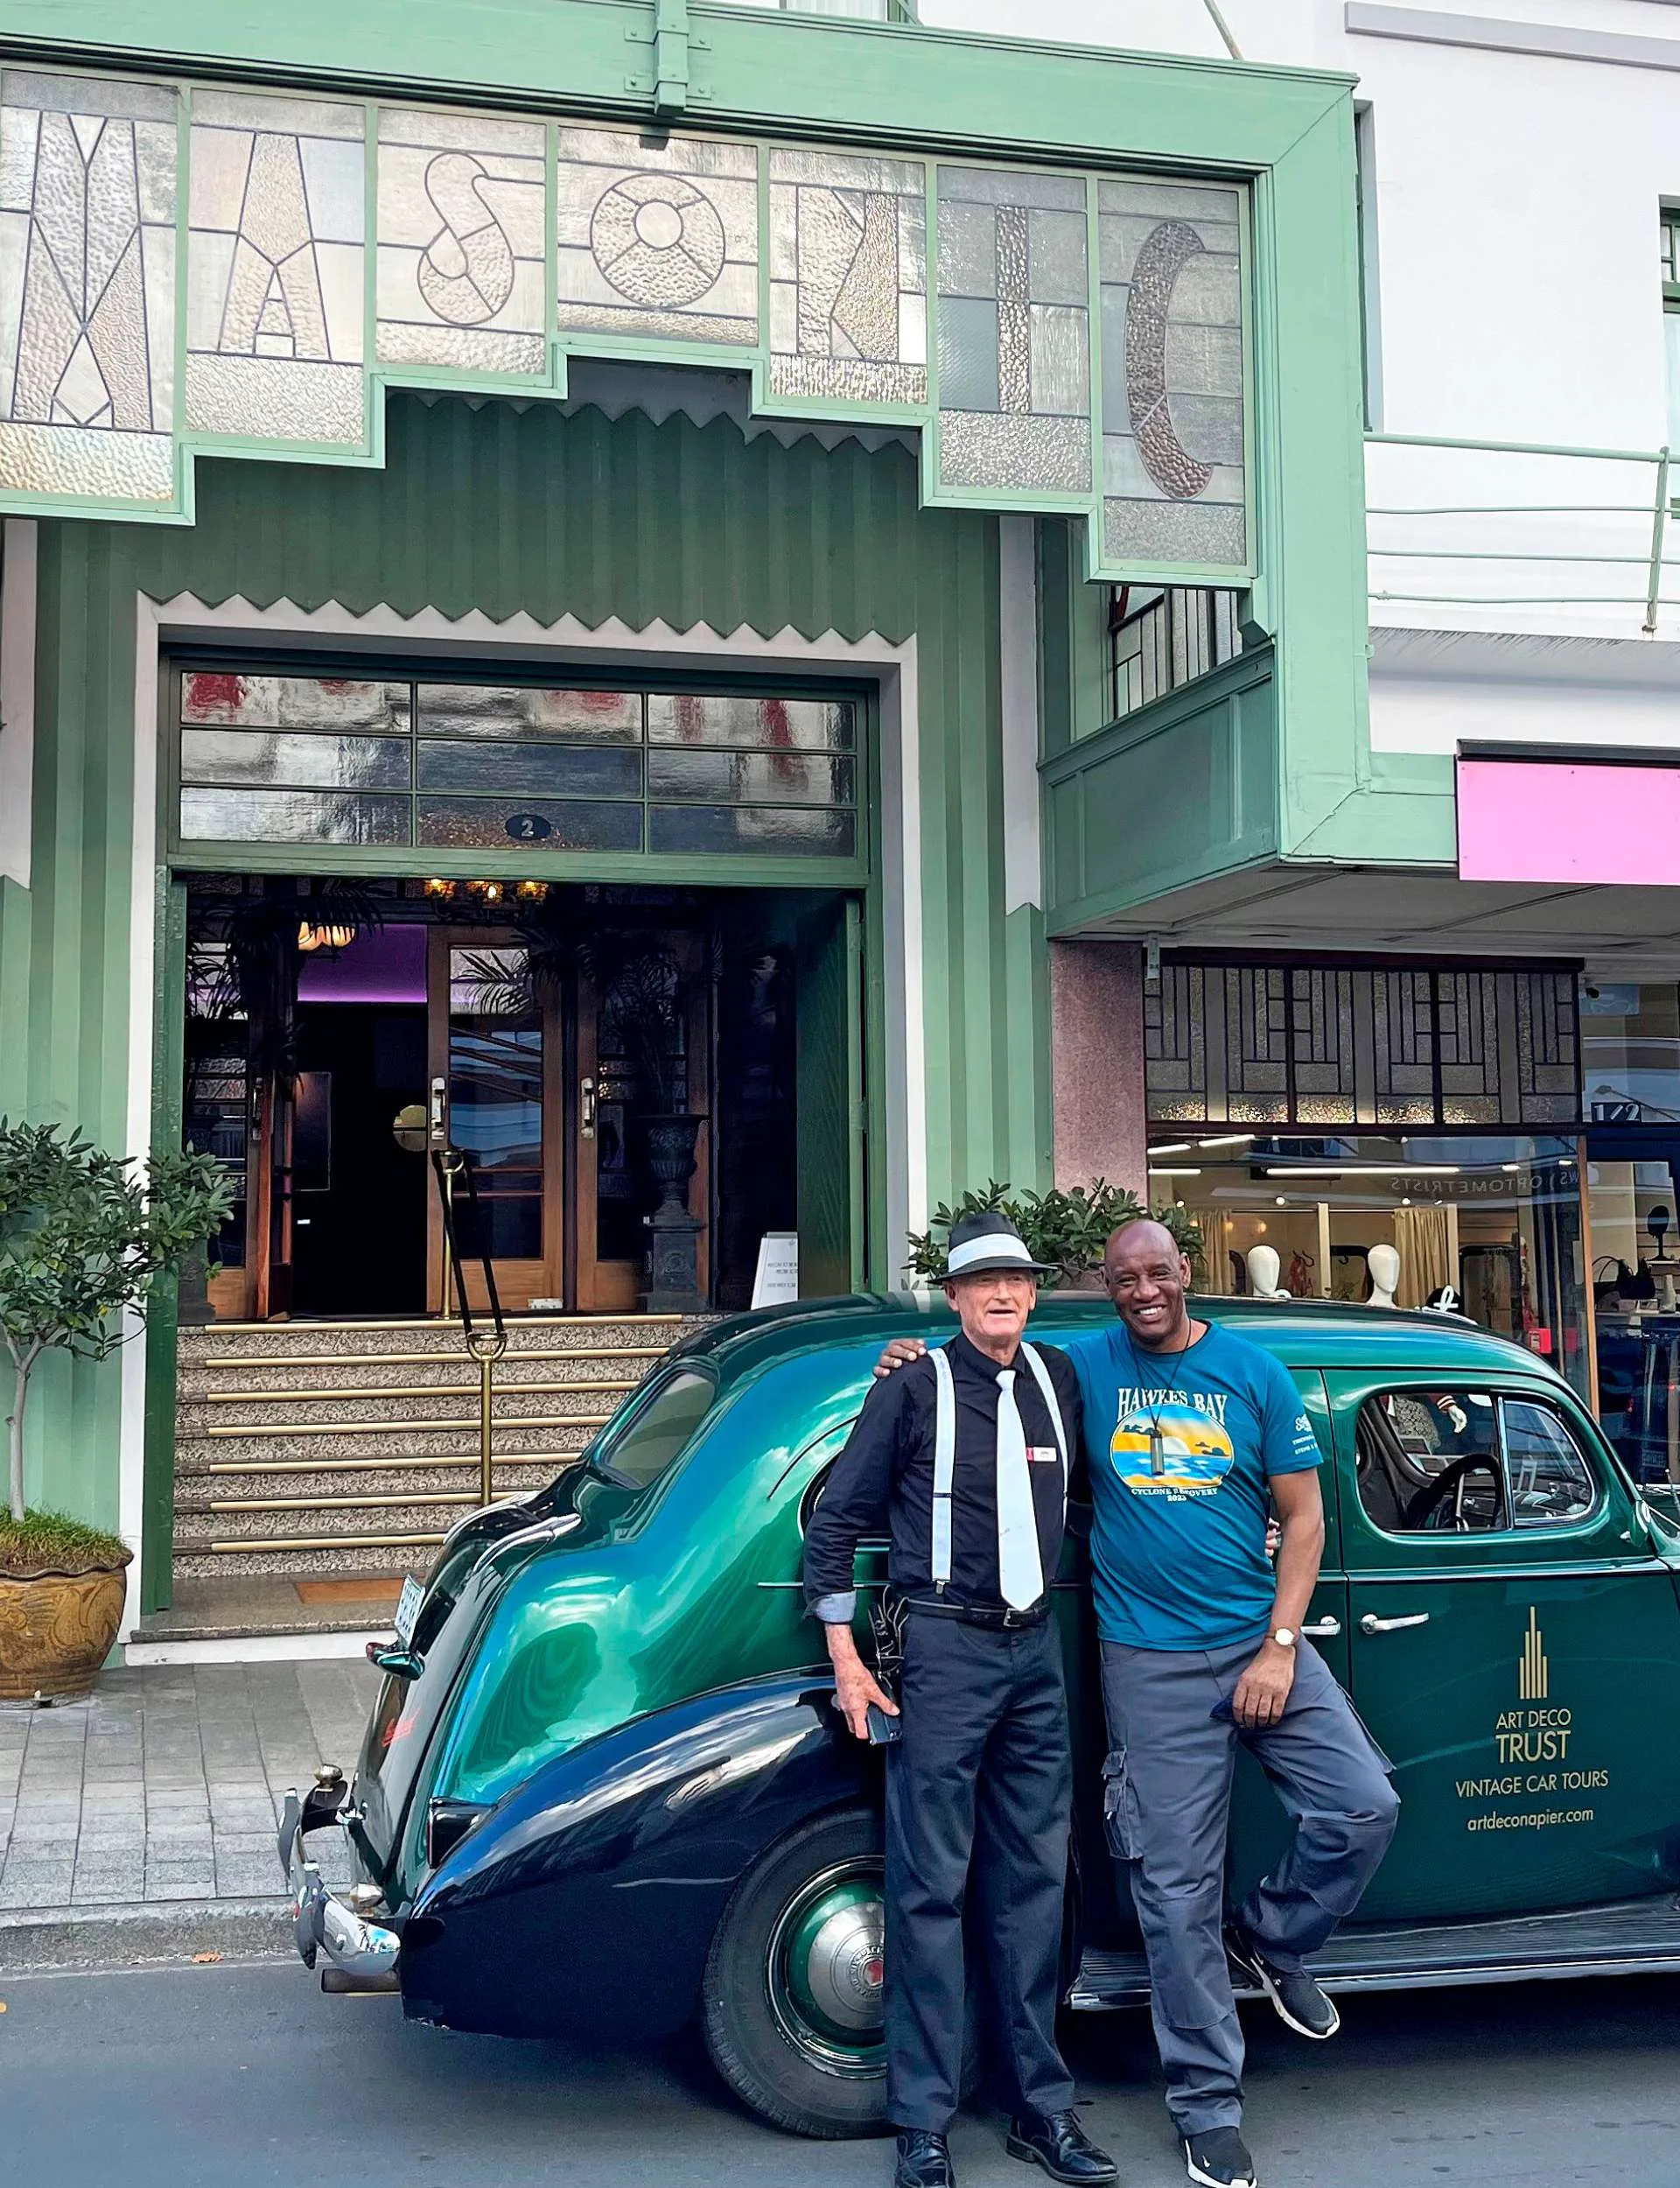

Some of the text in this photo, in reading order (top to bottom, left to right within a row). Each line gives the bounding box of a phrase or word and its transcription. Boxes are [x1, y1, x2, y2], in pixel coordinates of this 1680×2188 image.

[10, 107, 1214, 501] MASONIC
[522, 819, 534, 837] 2
[1593, 1103, 1640, 1121] 1/2
[1194, 1393, 1228, 1427] BAY
[1495, 1708, 1572, 1729] ART DECO
[1495, 1730, 1572, 1764] TRUST
[1456, 1770, 1609, 1798] VINTAGE CAR TOURS
[1467, 1808, 1594, 1831] artdeconapier.com
